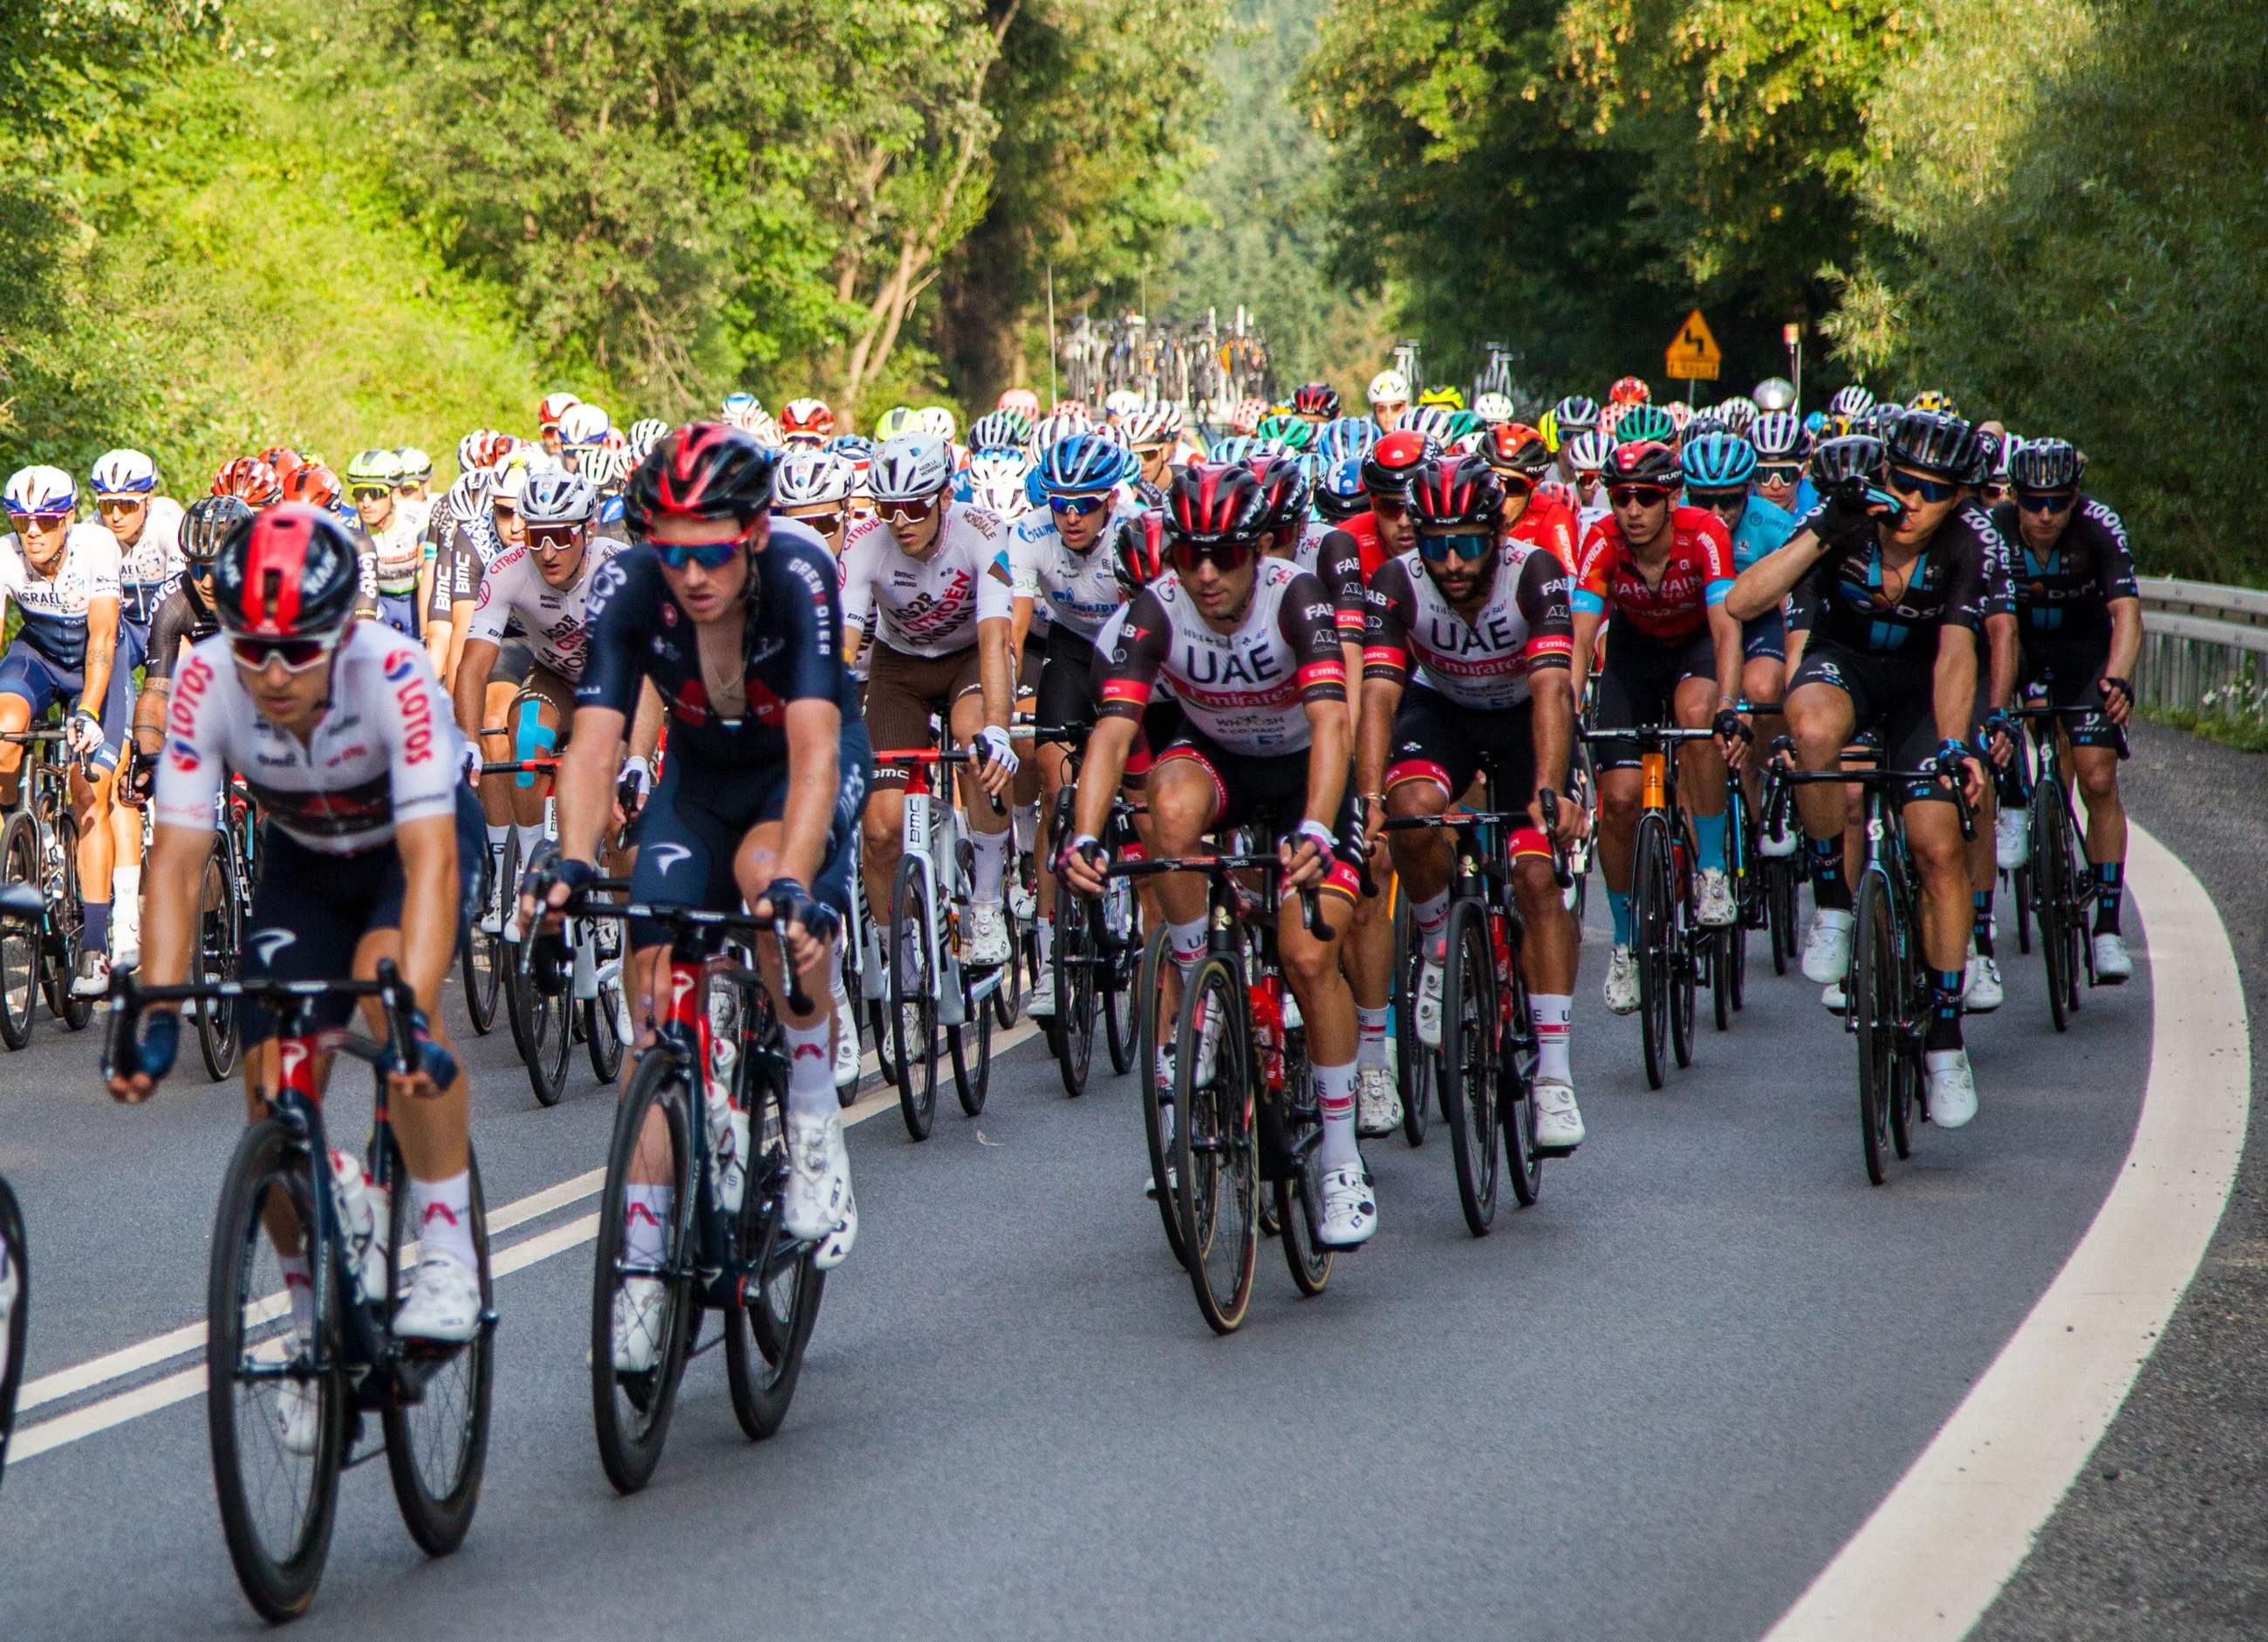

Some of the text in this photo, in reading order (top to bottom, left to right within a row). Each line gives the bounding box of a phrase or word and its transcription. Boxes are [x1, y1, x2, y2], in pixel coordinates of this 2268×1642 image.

[1657, 470, 1683, 482] RUDY
[962, 509, 997, 541] MONDIALE
[1961, 503, 1997, 581] zoover
[2083, 499, 2130, 553] zoover
[454, 551, 471, 593] BMC
[1555, 523, 1578, 575] MERIDA
[1578, 537, 1608, 585] MERIDA
[1697, 531, 1721, 577] MERIDA
[17, 592, 62, 605] ISRAEL
[435, 564, 452, 612] BMC
[788, 557, 830, 655] GRENADIER
[886, 592, 941, 621] AG2R
[902, 568, 971, 632] CITROËN
[540, 613, 580, 641] AG2R
[1431, 616, 1518, 655] UAE
[1187, 641, 1283, 685] UAE
[1430, 653, 1527, 677] Emirates
[169, 655, 215, 740] LOTOS
[1189, 682, 1295, 709] Emirates
[396, 678, 433, 766] LOTOS
[909, 798, 921, 844] BMC
